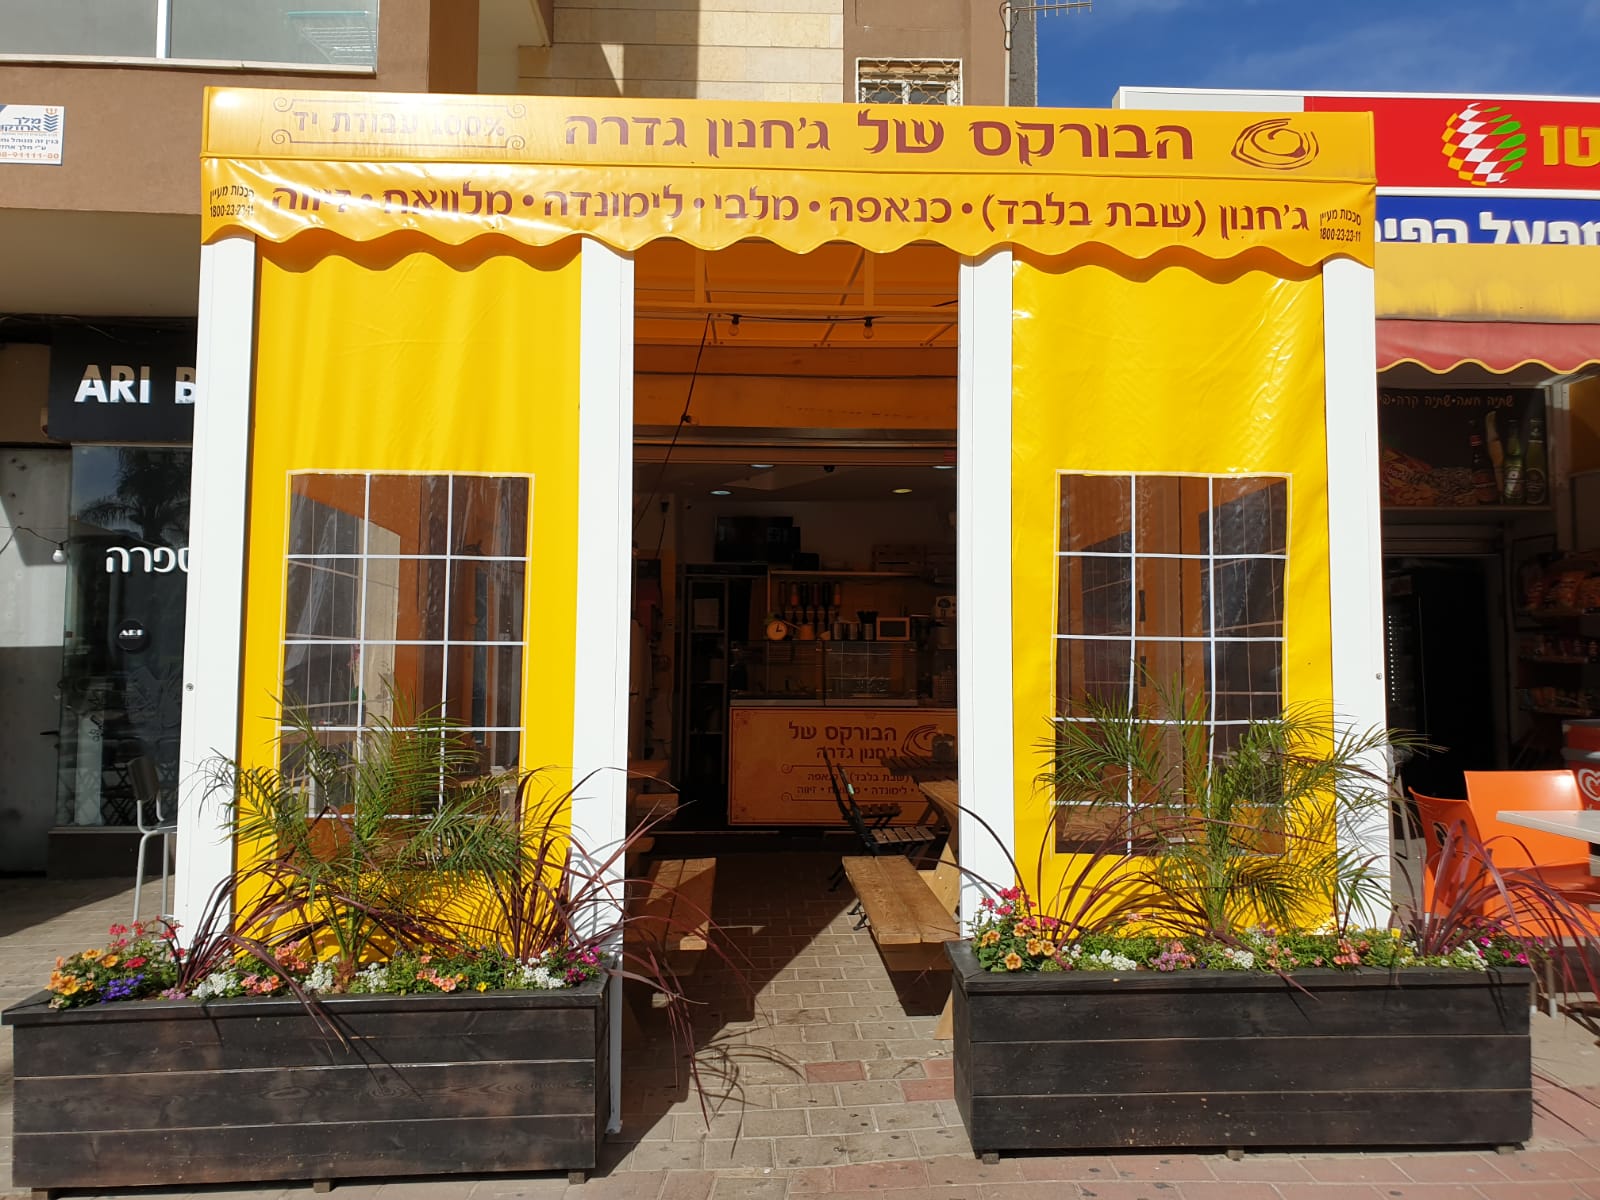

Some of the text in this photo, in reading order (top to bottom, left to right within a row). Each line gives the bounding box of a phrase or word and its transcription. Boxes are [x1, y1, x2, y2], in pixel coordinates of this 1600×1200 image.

[292, 111, 319, 132] יד
[331, 112, 419, 135] עבודת
[564, 109, 1194, 167] הבורקס של ג'חנון גדרה
[543, 183, 683, 219] לימונדה
[714, 185, 800, 222] מלבי
[829, 195, 952, 223] כנאפה
[981, 191, 1093, 233] בלבד)
[1105, 199, 1207, 238] (שבת
[1219, 204, 1310, 241] ג'חנון
[74, 364, 151, 404] ARI
[788, 720, 897, 746] הבורקס של
[816, 747, 855, 760] גדרה
